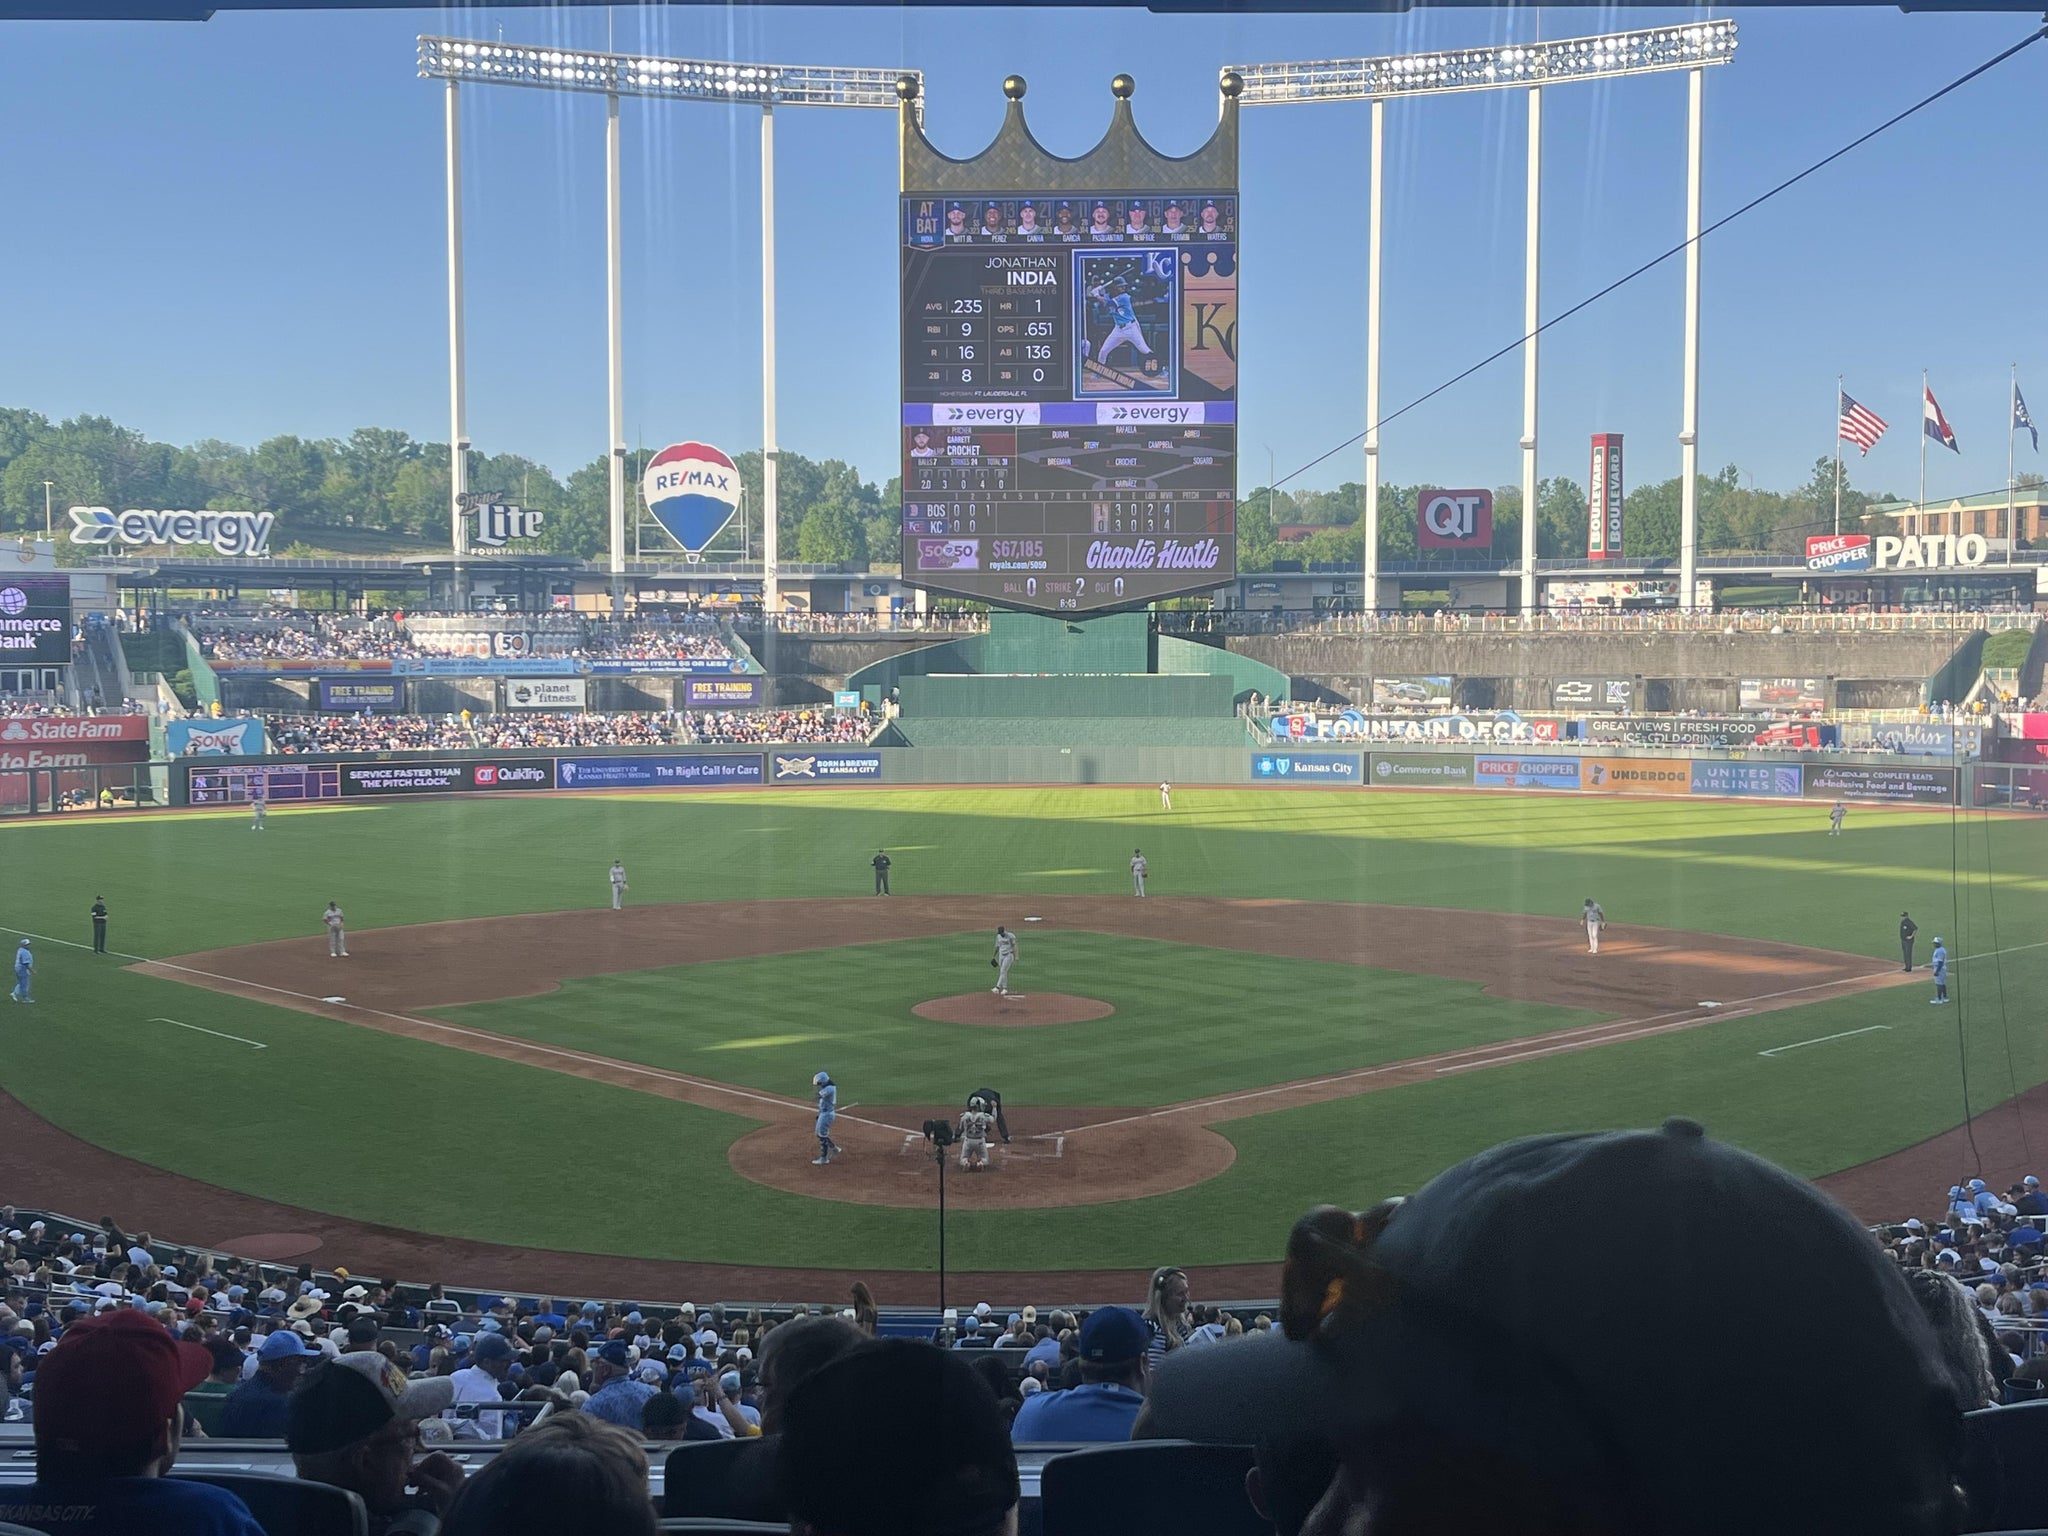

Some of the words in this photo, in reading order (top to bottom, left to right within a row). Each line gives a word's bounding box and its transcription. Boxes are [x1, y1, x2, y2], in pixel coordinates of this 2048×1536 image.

[920, 202, 934, 217] AT
[917, 218, 938, 233] BAT
[1207, 233, 1227, 241] WATERS
[985, 257, 1057, 269] JONATHAN
[1145, 252, 1172, 279] KC
[1007, 272, 1057, 285] INDIA
[951, 300, 982, 313] .235
[1035, 300, 1041, 313] 1
[961, 323, 972, 336] 9
[1024, 323, 1053, 336] .651
[958, 346, 975, 359] 16
[1025, 346, 1051, 359] 136
[1145, 359, 1158, 371] #6
[961, 369, 972, 382] 8
[1033, 369, 1044, 382] 0
[966, 408, 1025, 424] evergy
[1130, 407, 1189, 423] evergy
[1052, 431, 1070, 439] DURAN
[1115, 426, 1137, 434] RAFAELA
[947, 446, 980, 455] CROCHET
[1148, 441, 1173, 449] CAMPBELL
[1047, 458, 1072, 466] BREGMAN
[1115, 458, 1137, 466] CROCHET
[1193, 457, 1213, 465] SOGARD
[657, 470, 729, 491] RE/MAX
[1609, 454, 1620, 543] BOULEVARD
[927, 504, 945, 517] BOS
[954, 504, 960, 517] 0
[969, 504, 976, 517] 0
[986, 504, 990, 517] 1
[1425, 496, 1480, 538] QT
[475, 504, 544, 546] Lite
[930, 521, 943, 533] KC
[954, 520, 960, 532] 0
[969, 520, 976, 532] 0
[123, 515, 273, 551] evergy
[925, 546, 943, 557] 50
[954, 546, 973, 557] 50
[993, 540, 1043, 559] $67,185
[1810, 537, 1846, 554] PRICE
[1876, 533, 1988, 569] PATIO
[1086, 539, 1156, 568] Charlie
[1157, 539, 1219, 568] Hustle
[1808, 547, 1868, 569] CHOPPER
[990, 561, 1047, 571] royals.com/5050
[1004, 583, 1022, 593] BALL
[1026, 578, 1037, 596] 0
[1045, 582, 1072, 593] STRIKE
[1075, 578, 1086, 596] 2
[1095, 582, 1110, 593] OUT
[1114, 577, 1124, 596] 0
[0, 633, 37, 648] ank
[534, 684, 570, 695] planet
[692, 683, 712, 692] FREE
[714, 683, 752, 692] TRAINING
[538, 692, 577, 703] fitness
[1318, 719, 1448, 738] FOUNTAIN
[1459, 721, 1529, 738] DECK
[1535, 725, 1554, 738] QT
[1593, 721, 1631, 731] GREAT
[1634, 722, 1671, 731] VIEWS
[1680, 722, 1719, 732] FRESH
[1722, 723, 1756, 732] FOOD
[195, 735, 239, 748] SONIC
[350, 771, 392, 779] SERVICE
[394, 769, 431, 778] FASTER
[433, 768, 461, 776] THAN
[498, 767, 544, 782] QuikTrip
[656, 766, 674, 776] The
[675, 765, 700, 778] Right
[702, 765, 720, 775] Call
[722, 765, 736, 775] for
[737, 765, 759, 775] Care
[1294, 762, 1330, 773] Kansas
[1332, 762, 1353, 775] City
[1393, 765, 1442, 774] Commerce
[1444, 765, 1467, 775] Bank
[1482, 763, 1514, 774] PRICE
[1521, 764, 1574, 775] CHOPPER
[1707, 768, 1769, 778] UNITED
[477, 769, 494, 782] QT
[1611, 770, 1685, 781] UNDERDOG
[361, 780, 382, 788] THE
[383, 779, 412, 787] PITCH
[414, 778, 450, 786] CLOCK.
[1693, 779, 1769, 790] AIRLINES
[1813, 779, 1864, 788] All-Inclusive
[1866, 781, 1886, 789] Food
[1888, 782, 1904, 790] and
[1907, 782, 1947, 793] Beverage
